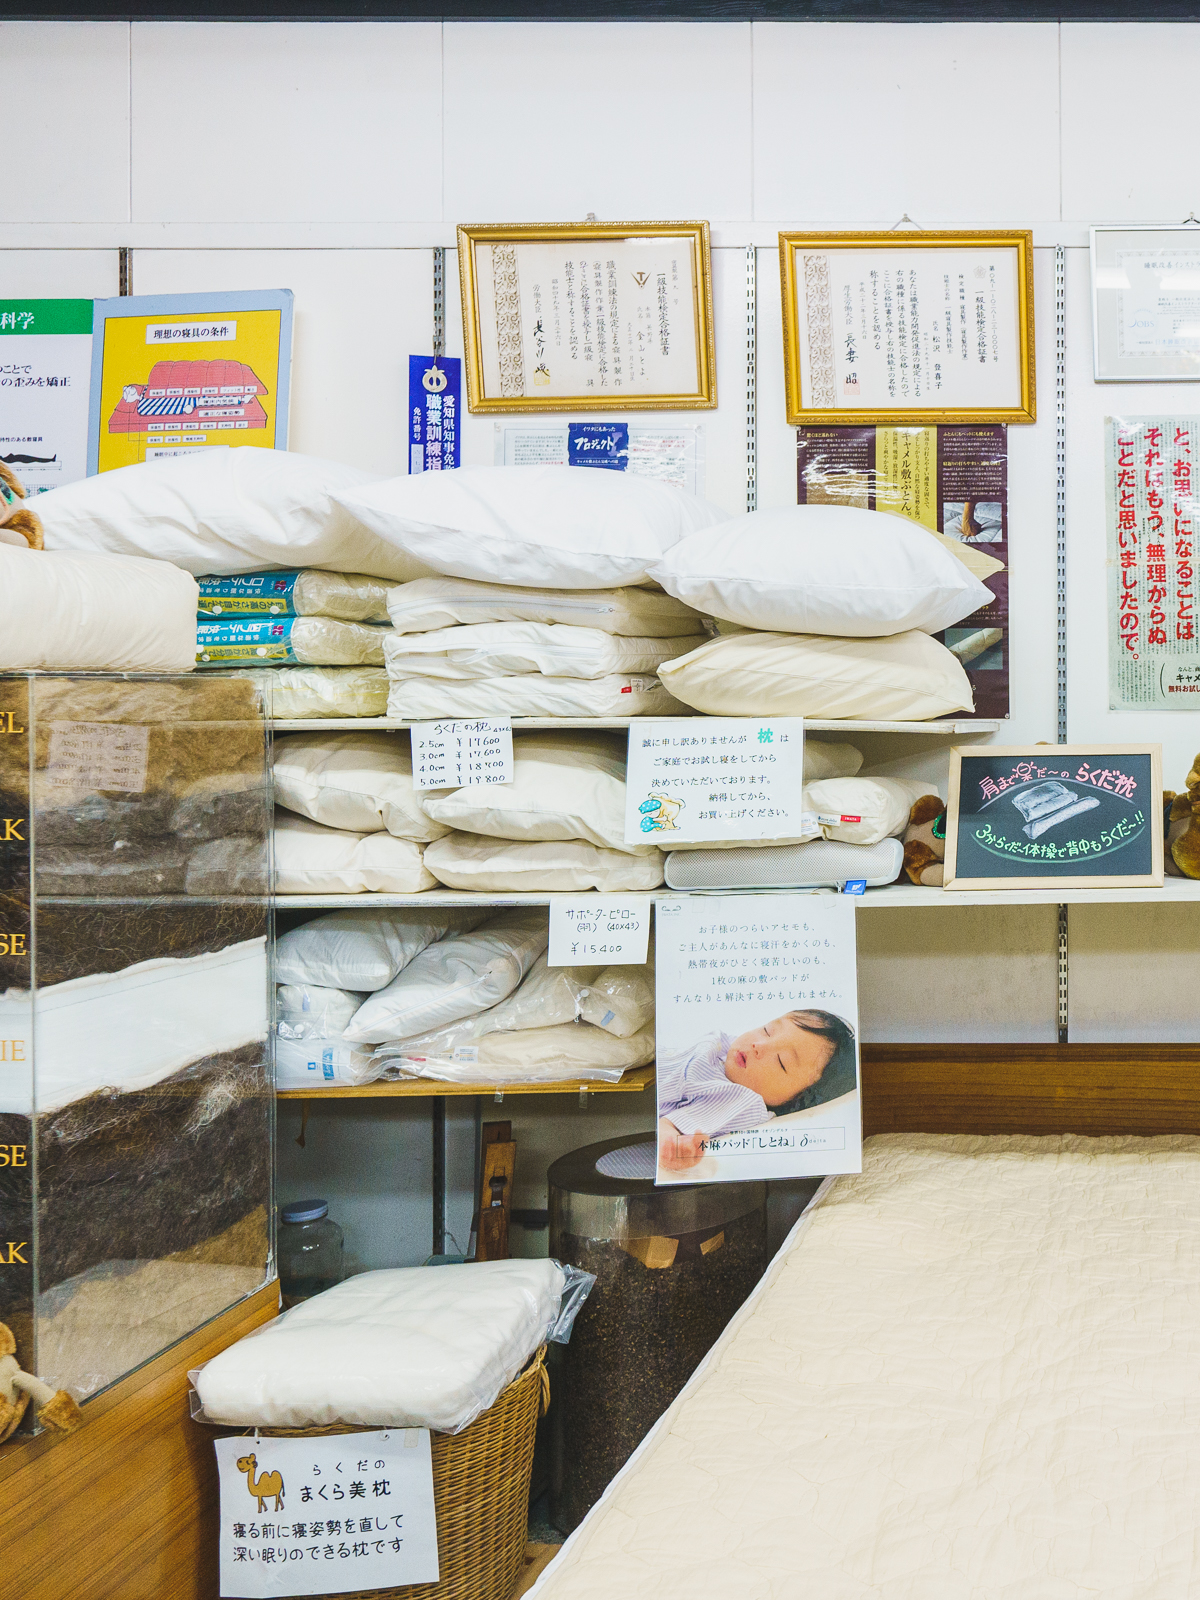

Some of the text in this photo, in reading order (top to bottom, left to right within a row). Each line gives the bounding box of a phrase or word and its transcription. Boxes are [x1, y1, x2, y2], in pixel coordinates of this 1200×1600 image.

[656, 272, 670, 356] 一級技能検定合格証書
[869, 270, 882, 350] 称することを認める
[154, 326, 230, 340] 理想の寝具の条件
[975, 290, 988, 364] 一級技能検定合格証書
[413, 406, 421, 441] 免許番号
[443, 394, 455, 470] 愛知県知事免
[574, 436, 614, 450] プロジェクト
[901, 432, 912, 516] キャメル敷ぶとん。
[1144, 427, 1167, 646] それはもう、無理からぬ
[642, 728, 789, 748] 誠に申し訳ありませんが 枕 は
[653, 754, 777, 766] ご家庭でお試し寝をしてから
[651, 775, 771, 788] 決めていただいております。
[709, 792, 771, 802] 納得してから、
[698, 809, 789, 820] お買い上げください。
[0, 818, 25, 841] K
[699, 922, 816, 934] お子様のつらいアセモも、
[679, 939, 836, 952] ご主人があんなに寝汗をかくのも、
[688, 956, 826, 969] 熱帯夜がひどく寝苦しいのも、
[712, 974, 810, 985] 1枚の麻の敷パッドが
[673, 990, 844, 1003] すんなりと解決するかもしれません。
[698, 1136, 795, 1152] 本麻パッド「しとね」
[0, 1242, 28, 1263] K
[313, 1460, 385, 1476] らくだの
[300, 1479, 391, 1502] まくら美枕
[233, 1514, 404, 1539] 寝る前に寝姿勢を直して
[233, 1536, 404, 1563] 深い眠りのできる枕です
